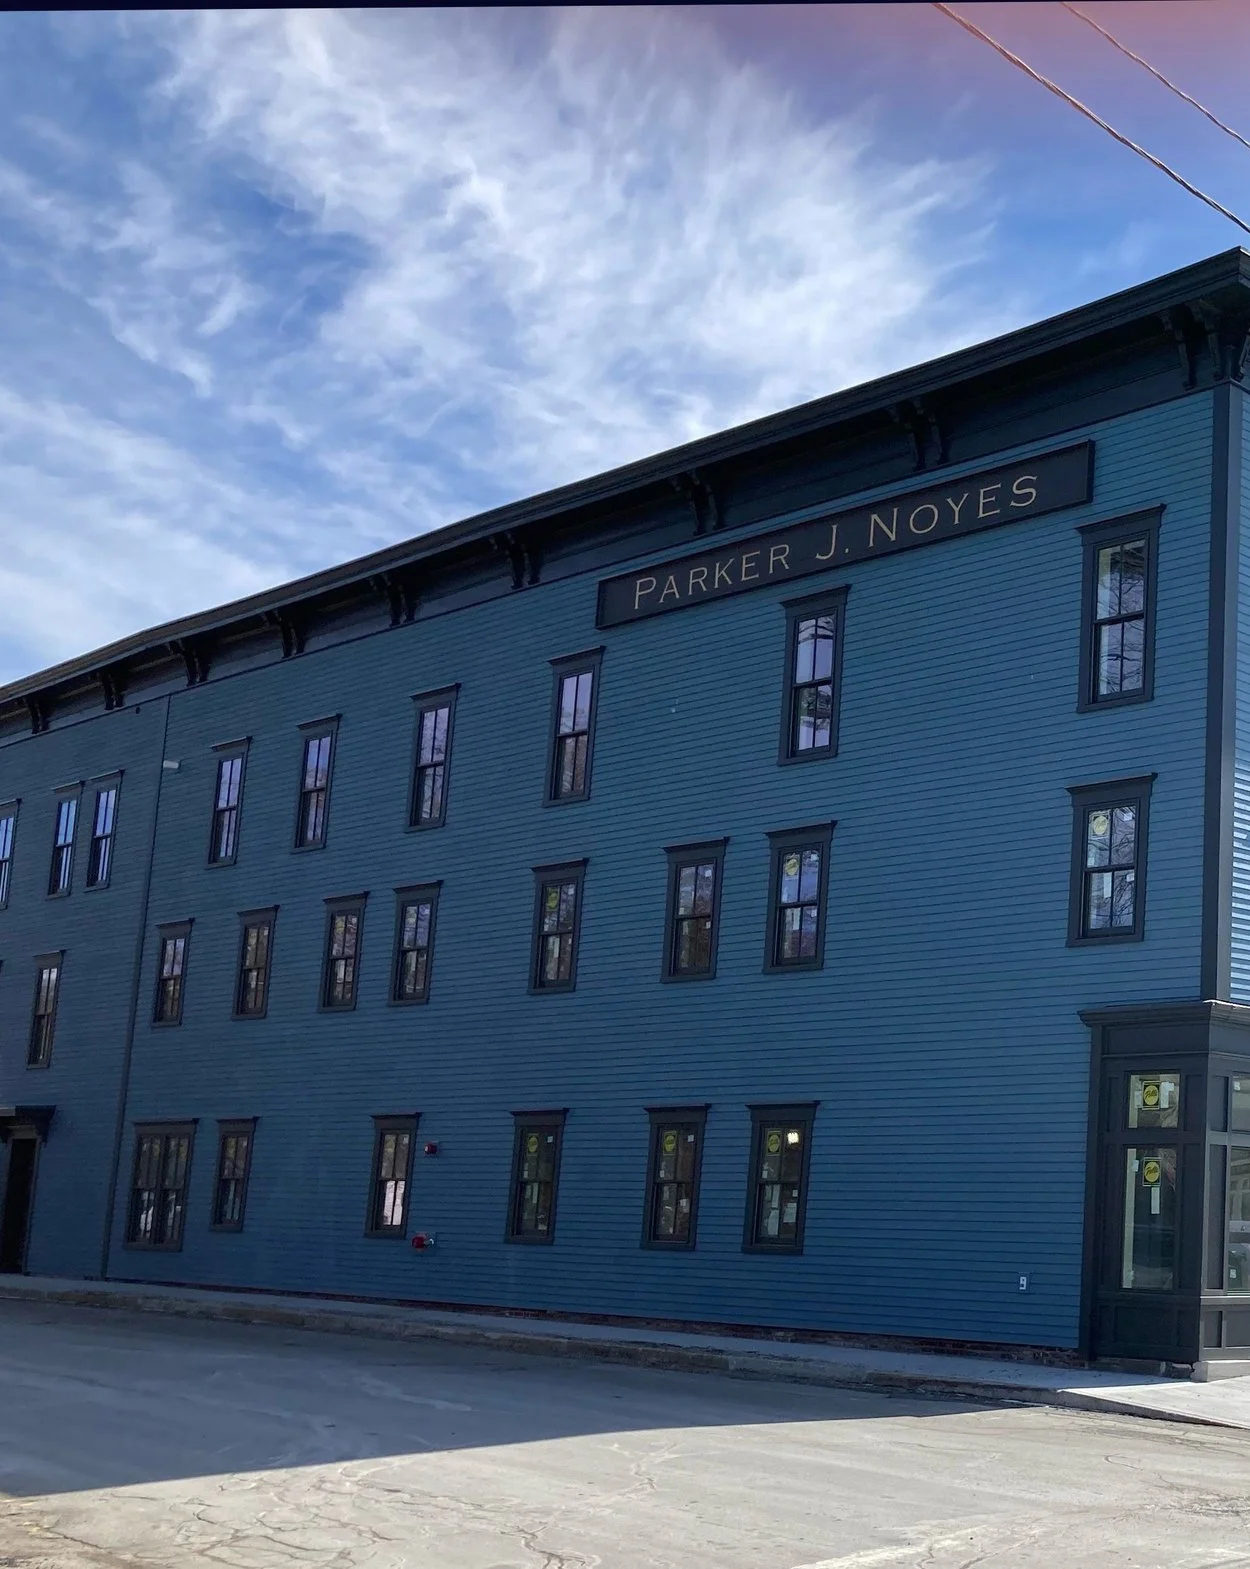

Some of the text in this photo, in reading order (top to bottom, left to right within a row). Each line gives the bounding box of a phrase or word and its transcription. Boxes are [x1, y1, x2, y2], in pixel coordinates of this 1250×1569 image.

[634, 475, 1038, 609] PARKER J. NOYES
